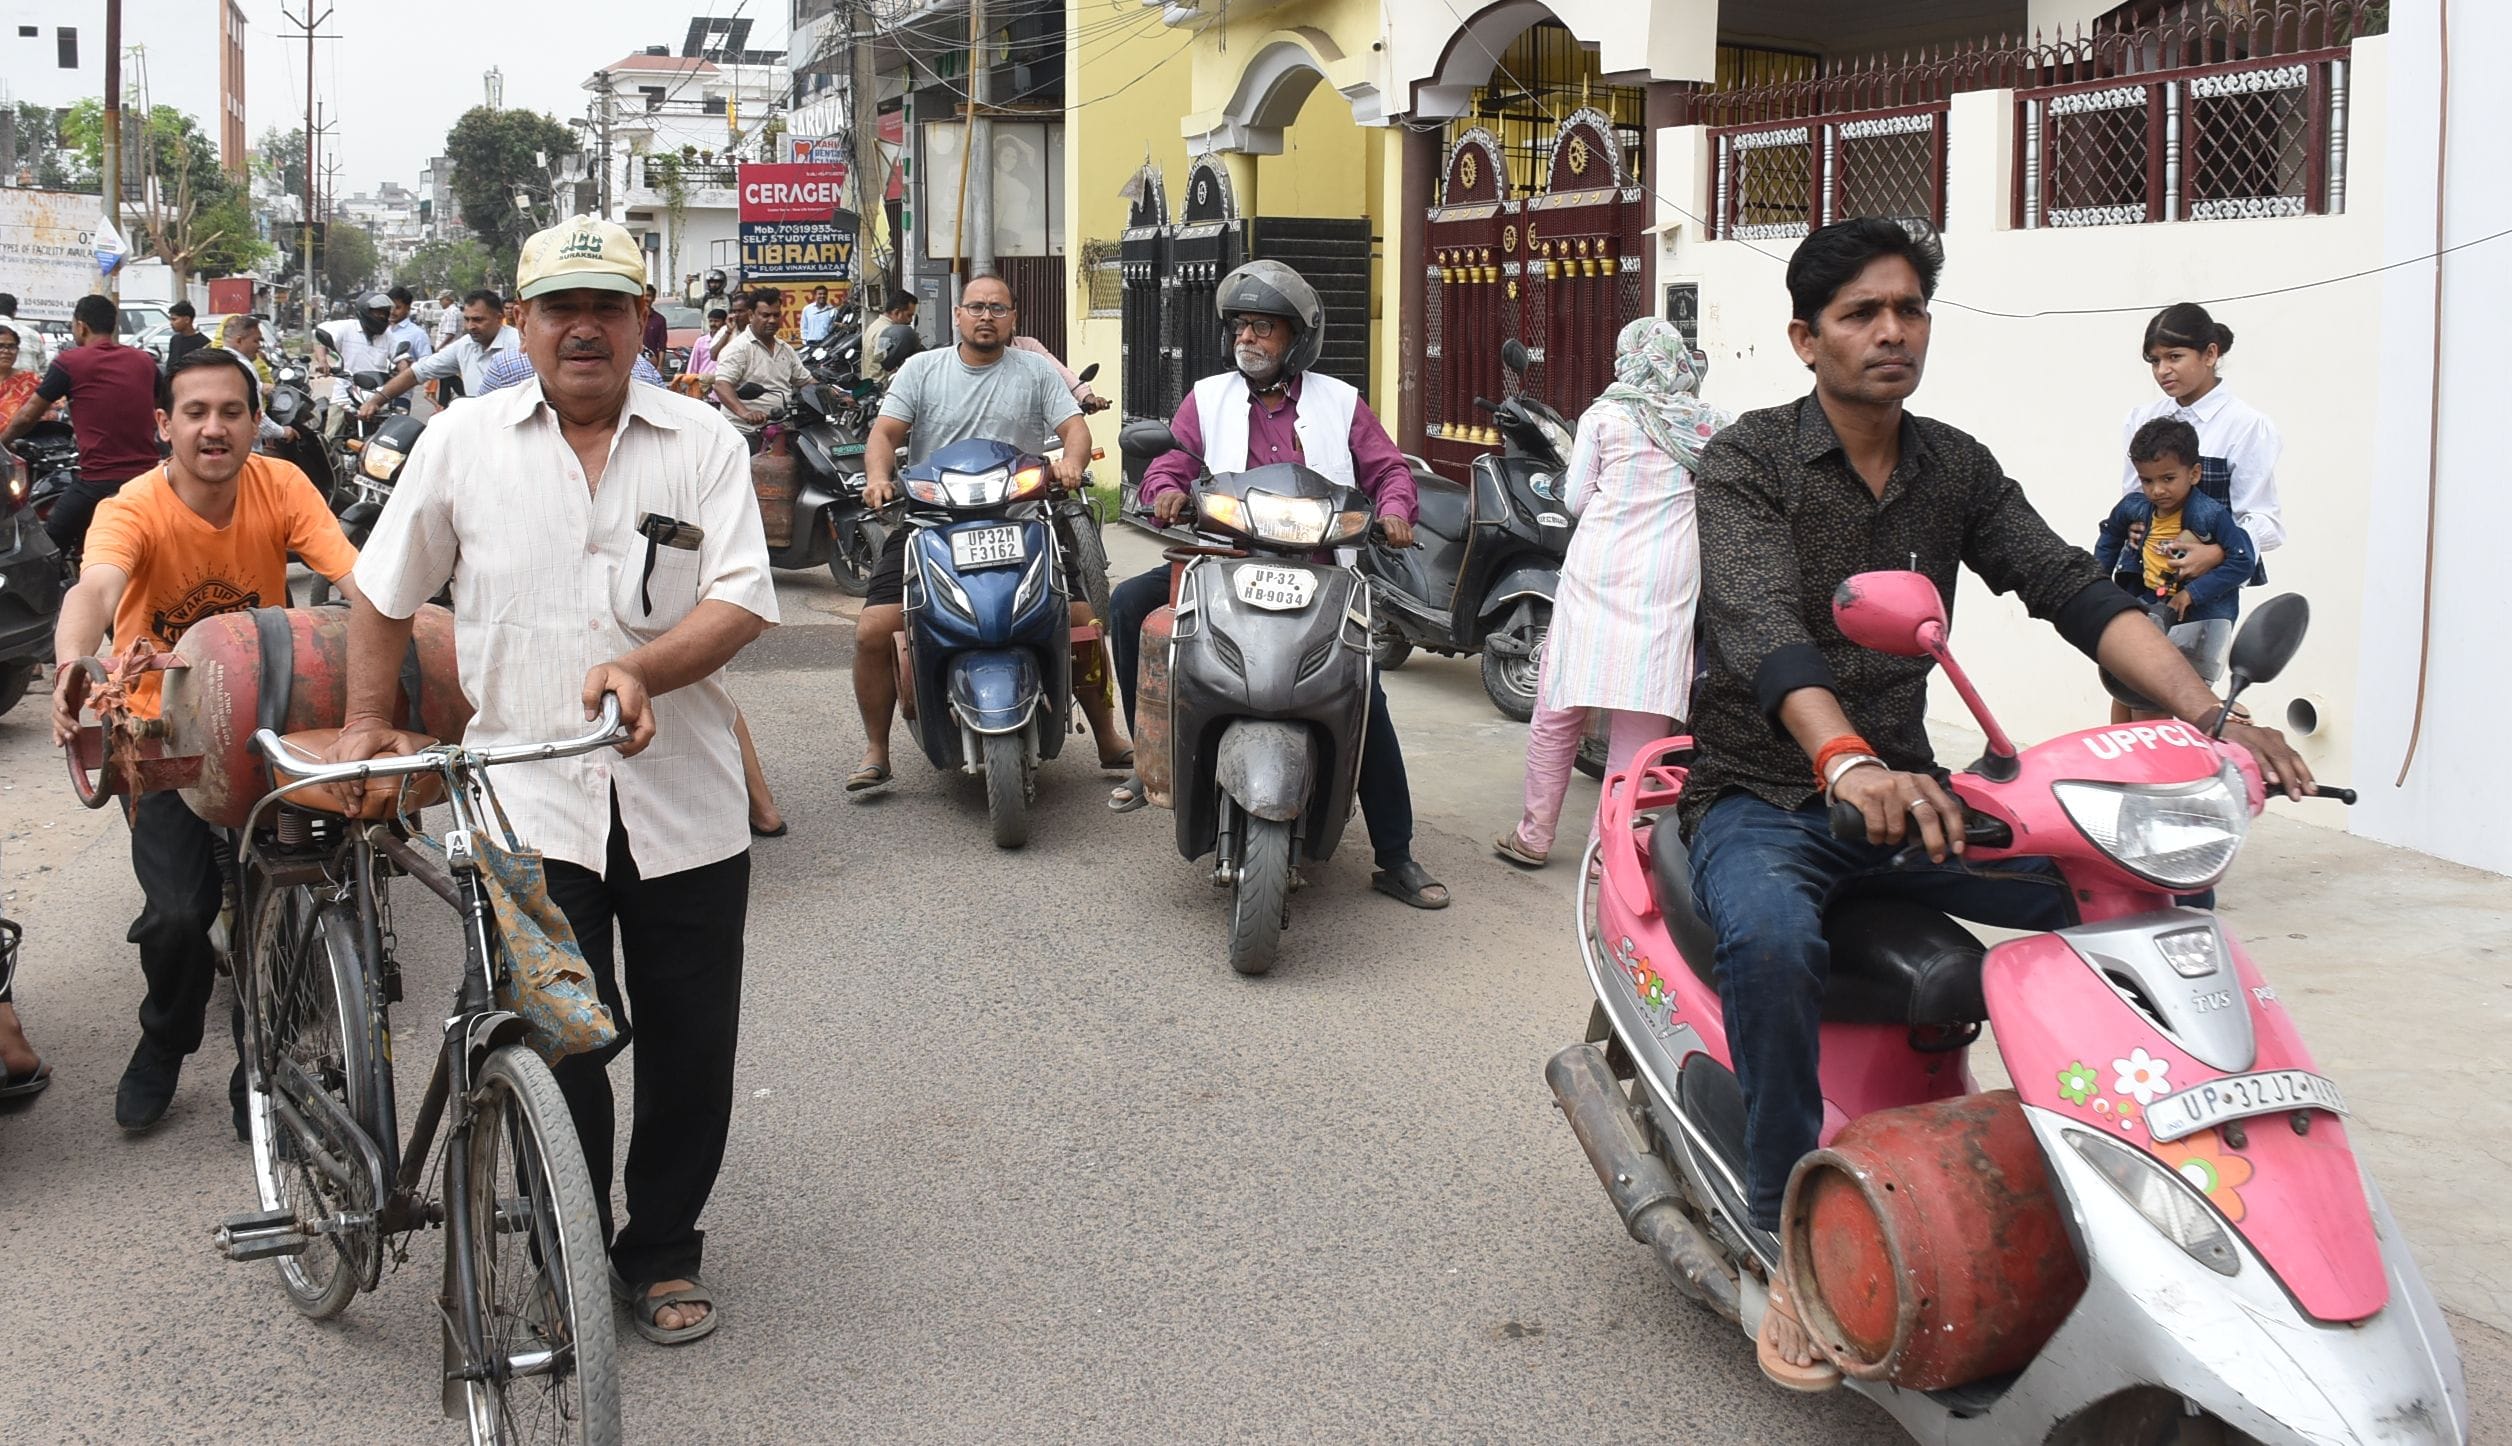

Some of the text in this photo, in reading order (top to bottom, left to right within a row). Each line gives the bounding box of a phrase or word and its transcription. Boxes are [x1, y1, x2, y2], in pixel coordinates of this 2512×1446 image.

[560, 230, 603, 252] ACC
[743, 233, 851, 243] SELF STUDY CENTRE
[742, 243, 851, 265] LIBRARY
[818, 263, 846, 271] BAZAR
[968, 527, 1015, 546] UP32M
[970, 543, 1017, 561] F3162
[1255, 570, 1296, 586] UP-32
[174, 587, 209, 620] WAKE
[212, 586, 234, 601] UP
[1244, 586, 1304, 605] HB-9034
[224, 691, 232, 714] ONLY
[2081, 725, 2210, 760] UPPCL
[2191, 989, 2232, 1014] TVS
